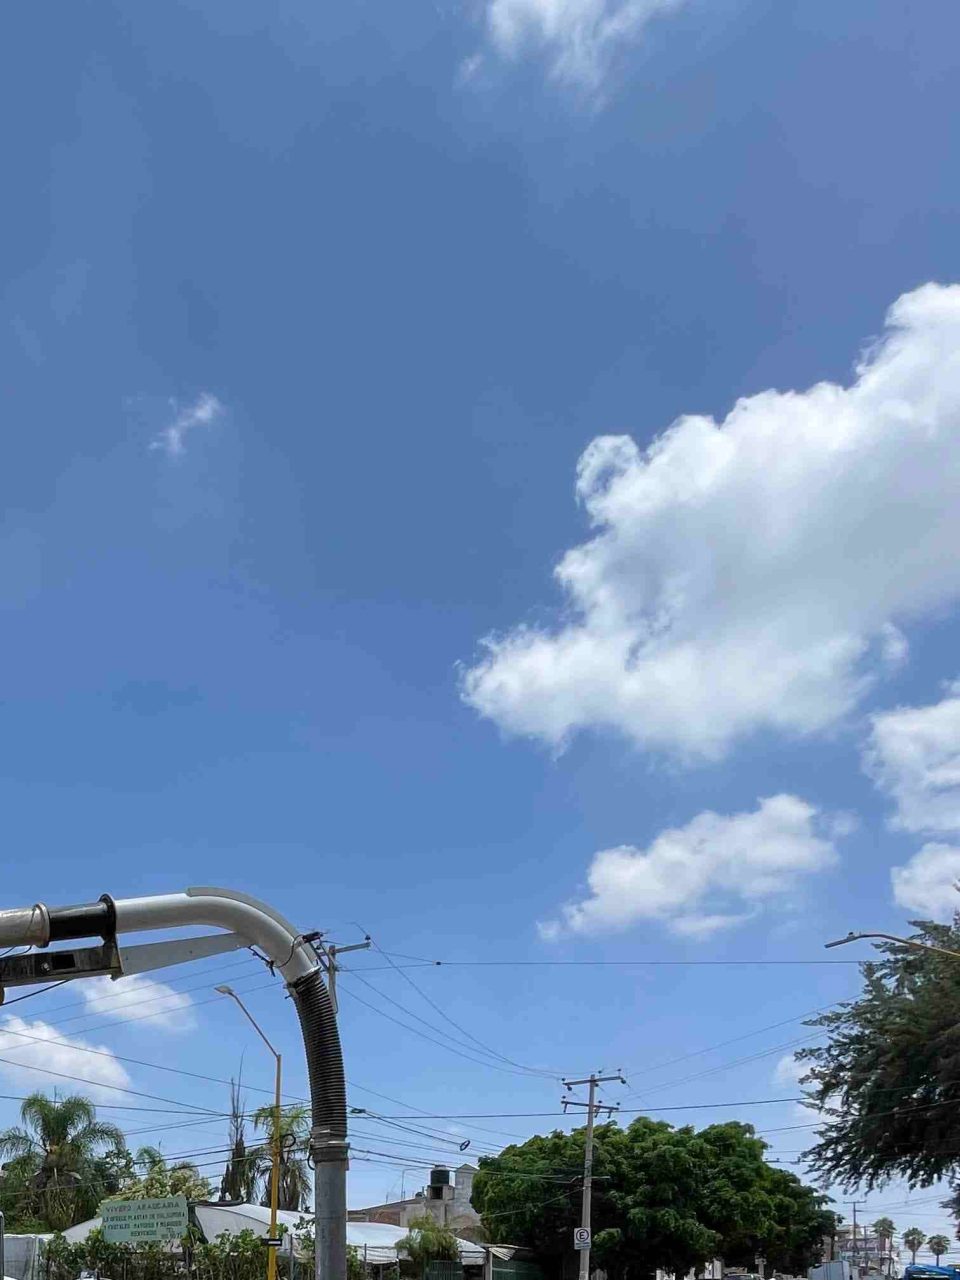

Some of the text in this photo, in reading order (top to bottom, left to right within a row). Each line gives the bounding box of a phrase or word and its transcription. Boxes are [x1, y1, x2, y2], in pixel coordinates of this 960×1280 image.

[105, 1201, 179, 1213] VIVERO ARAUCARIA
[579, 1231, 586, 1240] E
